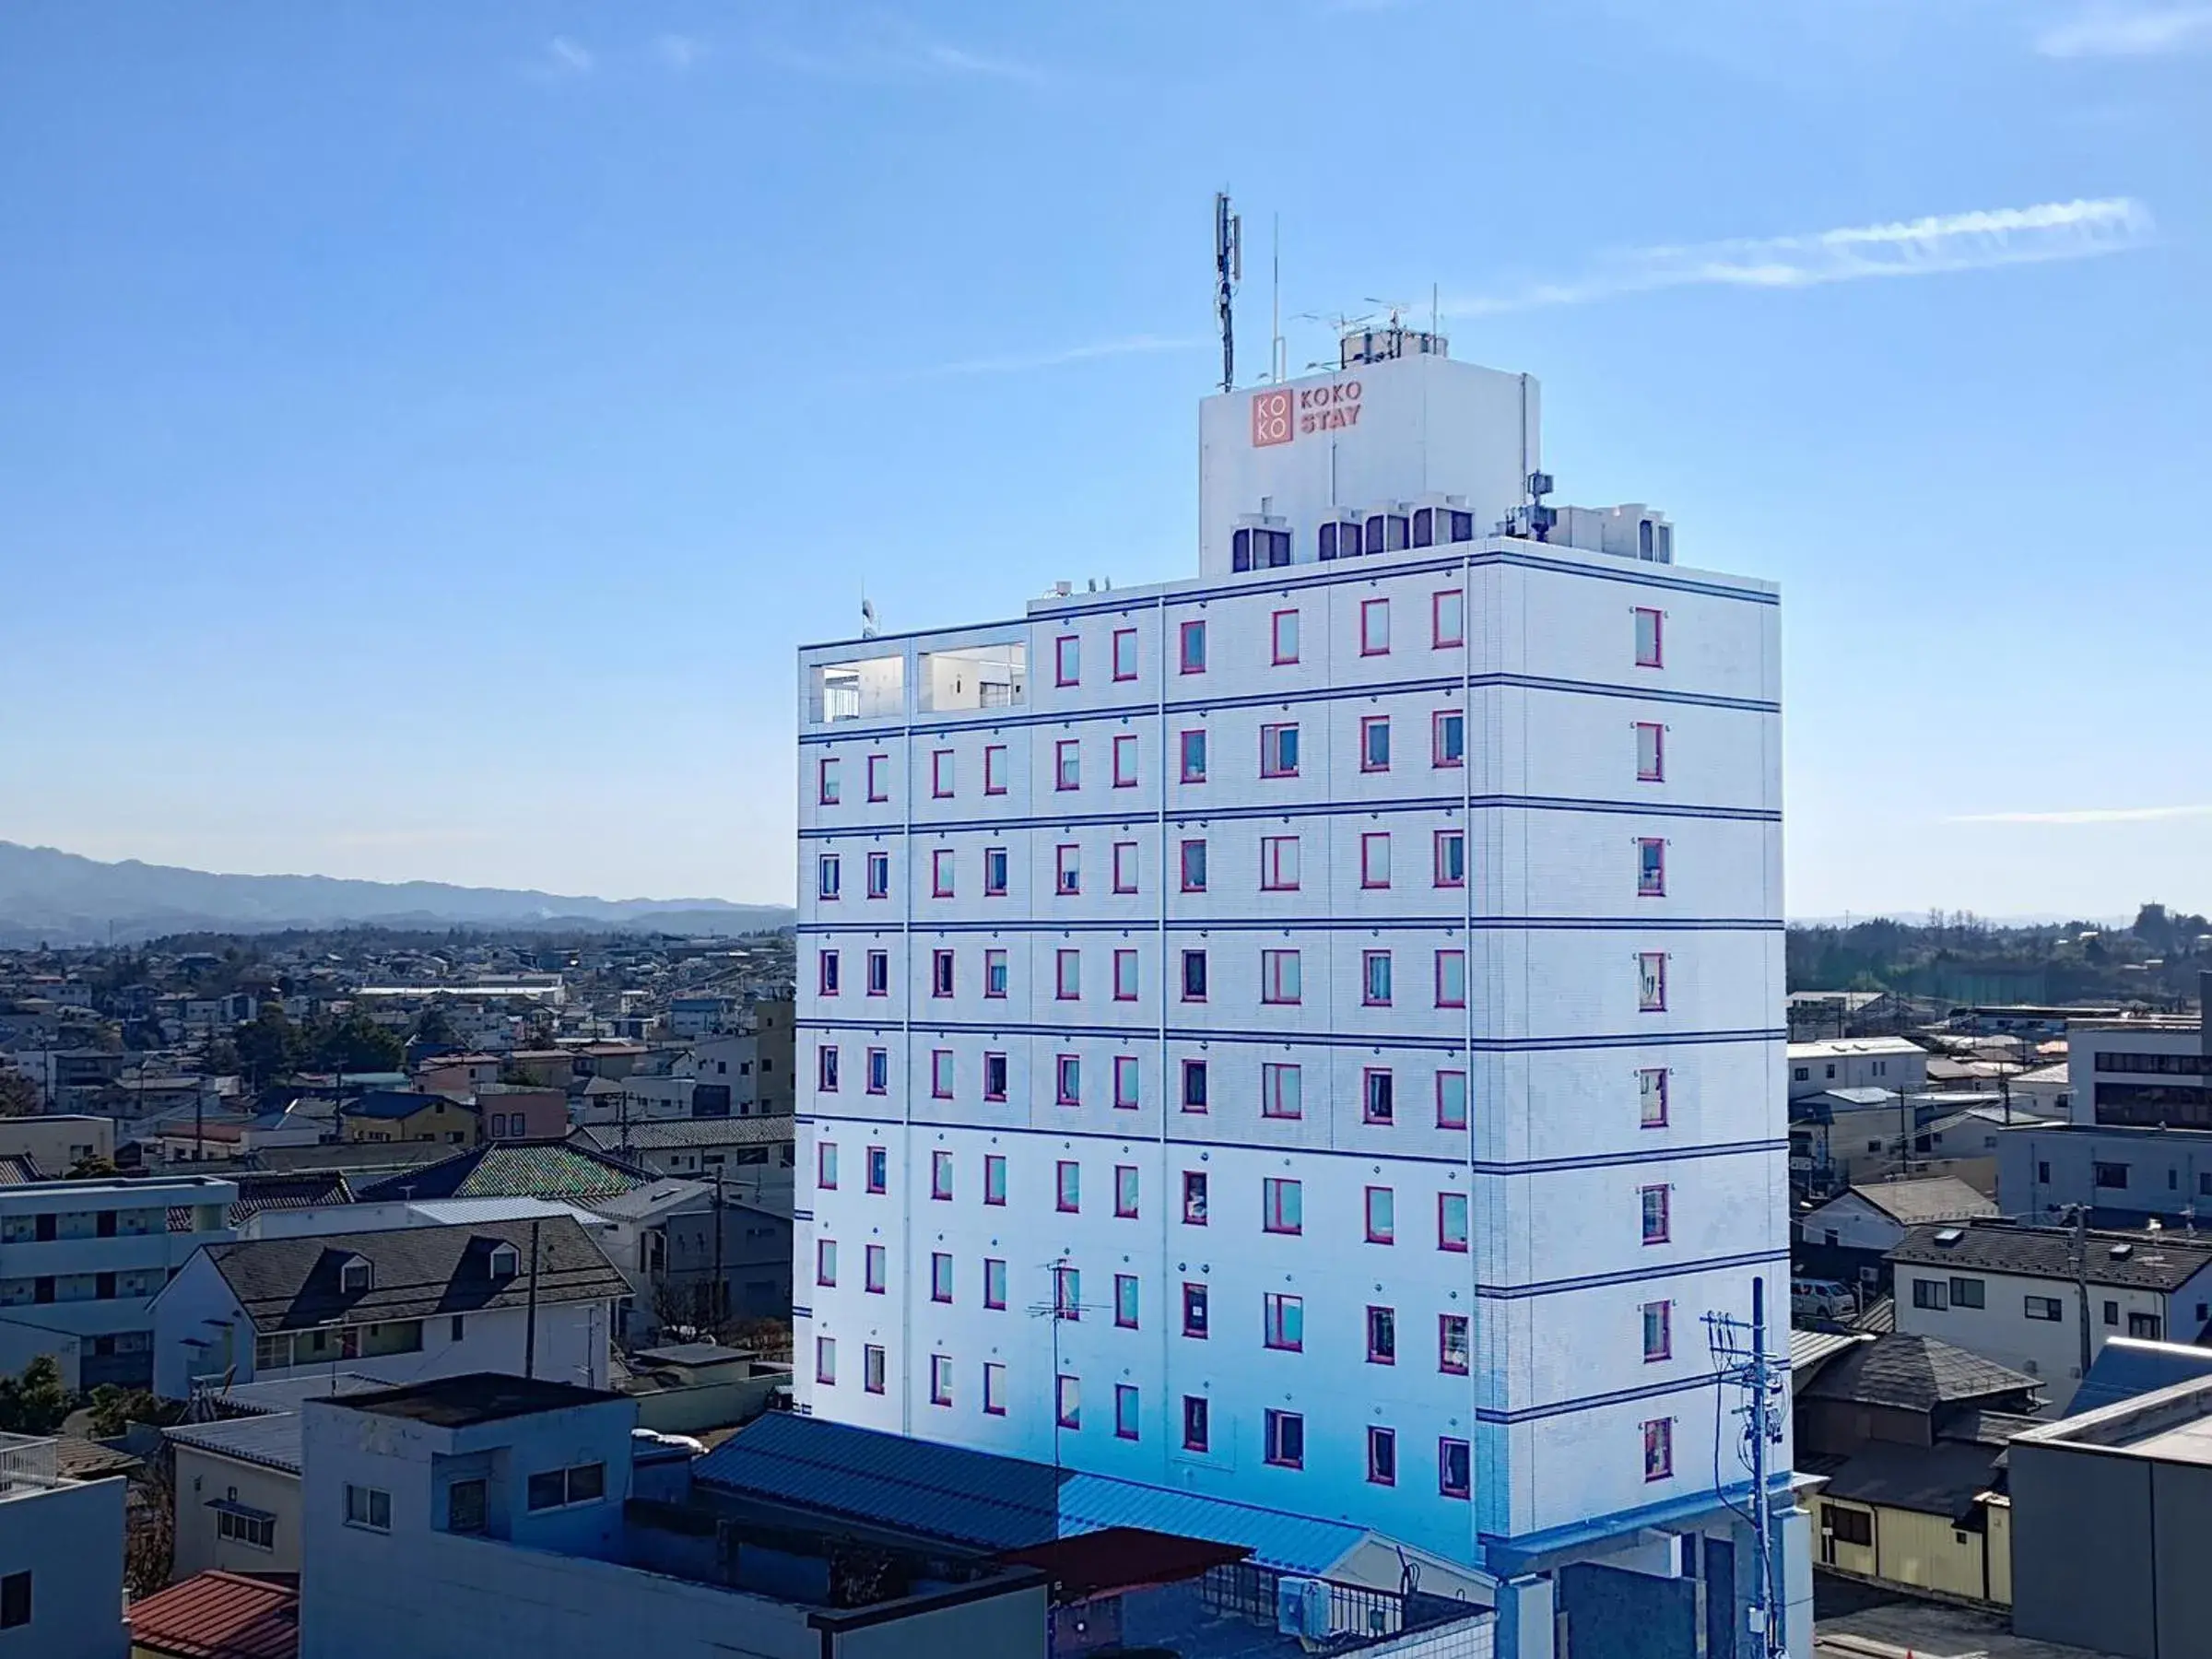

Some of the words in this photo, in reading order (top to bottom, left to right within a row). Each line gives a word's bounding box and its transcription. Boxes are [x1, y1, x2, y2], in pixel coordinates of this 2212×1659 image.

[1257, 395, 1286, 418] KO
[1300, 382, 1362, 409] KOKO
[1257, 418, 1286, 441] KO
[1300, 404, 1361, 433] STAY
